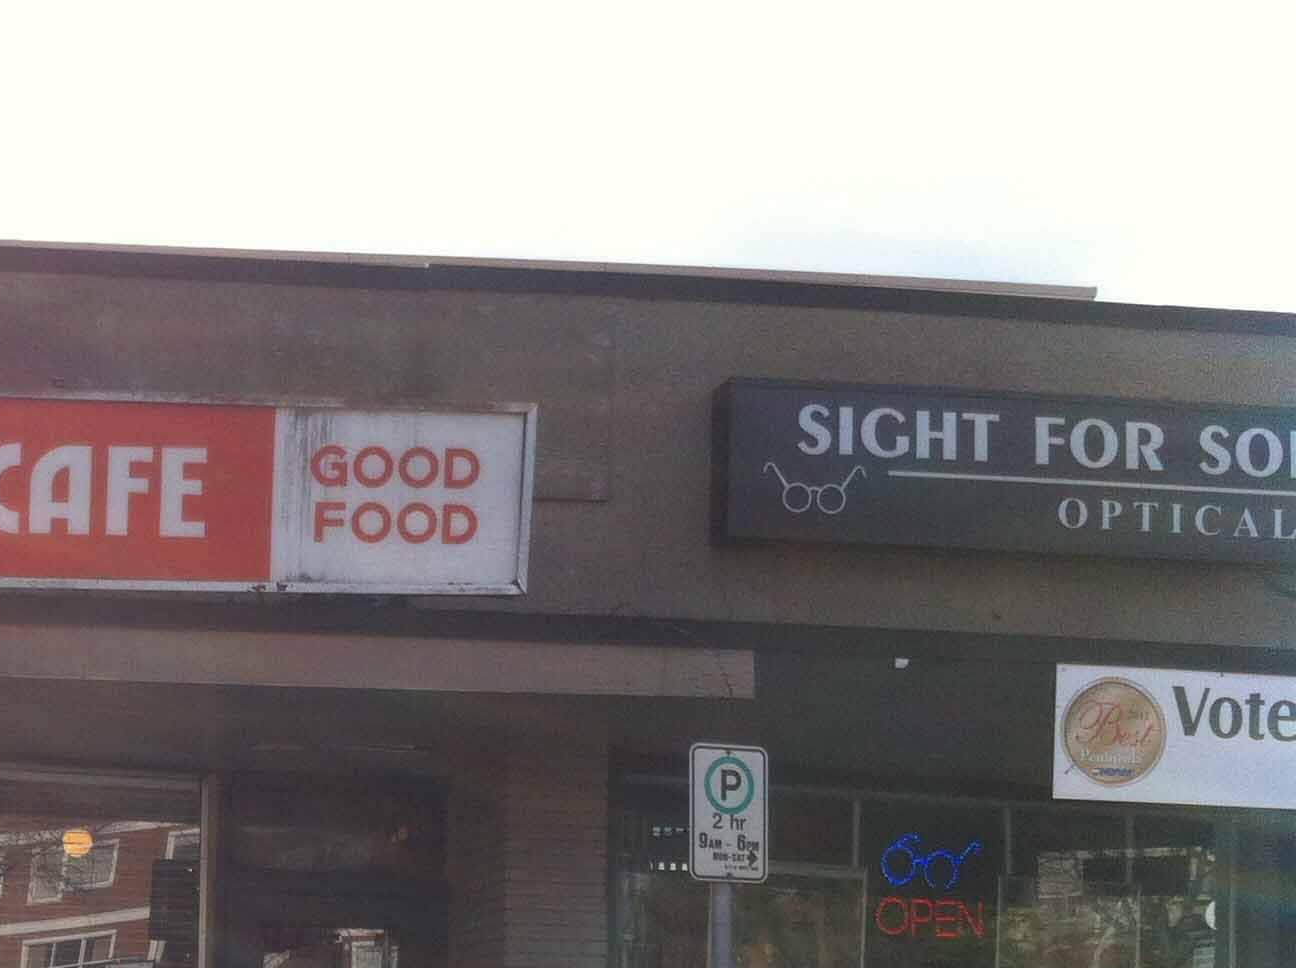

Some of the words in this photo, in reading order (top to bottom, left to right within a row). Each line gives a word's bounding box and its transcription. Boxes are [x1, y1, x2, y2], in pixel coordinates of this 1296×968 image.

[797, 403, 1000, 462] SIGHT
[1034, 416, 1165, 471] FOR
[1199, 425, 1296, 479] SO
[310, 445, 480, 489] GOOD
[312, 501, 478, 545] FOOD
[1057, 498, 1296, 540] OPTICAL
[1172, 685, 1296, 742] Vote
[720, 769, 742, 802] P
[698, 832, 722, 849] 9AM
[737, 834, 760, 852] 6PM
[712, 812, 723, 830] 2
[729, 814, 747, 831] hr
[874, 896, 985, 939] OPEN
